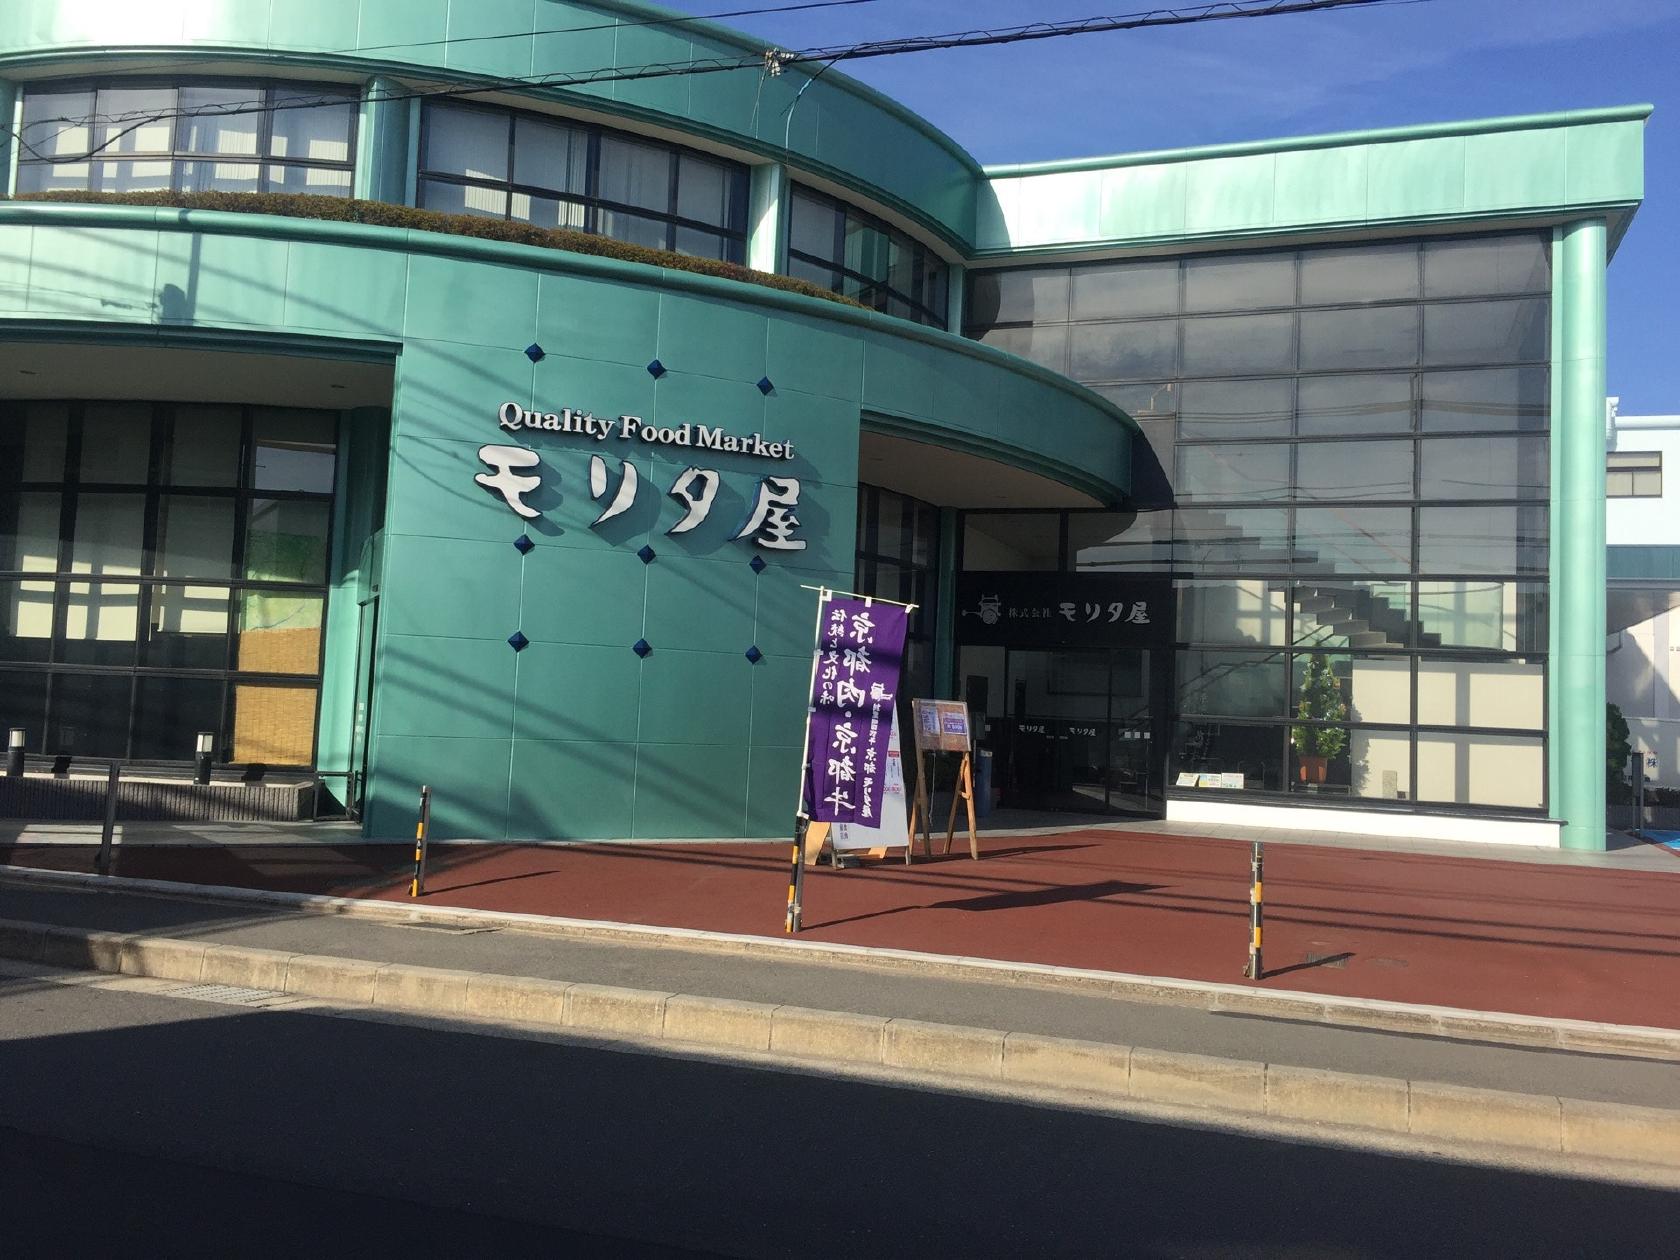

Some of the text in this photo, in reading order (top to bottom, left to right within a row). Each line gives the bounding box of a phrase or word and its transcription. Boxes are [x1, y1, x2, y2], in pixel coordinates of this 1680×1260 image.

[499, 402, 796, 460] Quality Food Market
[474, 444, 807, 550] モリタ屋
[1008, 601, 1151, 624] 株式会社 モリタ屋
